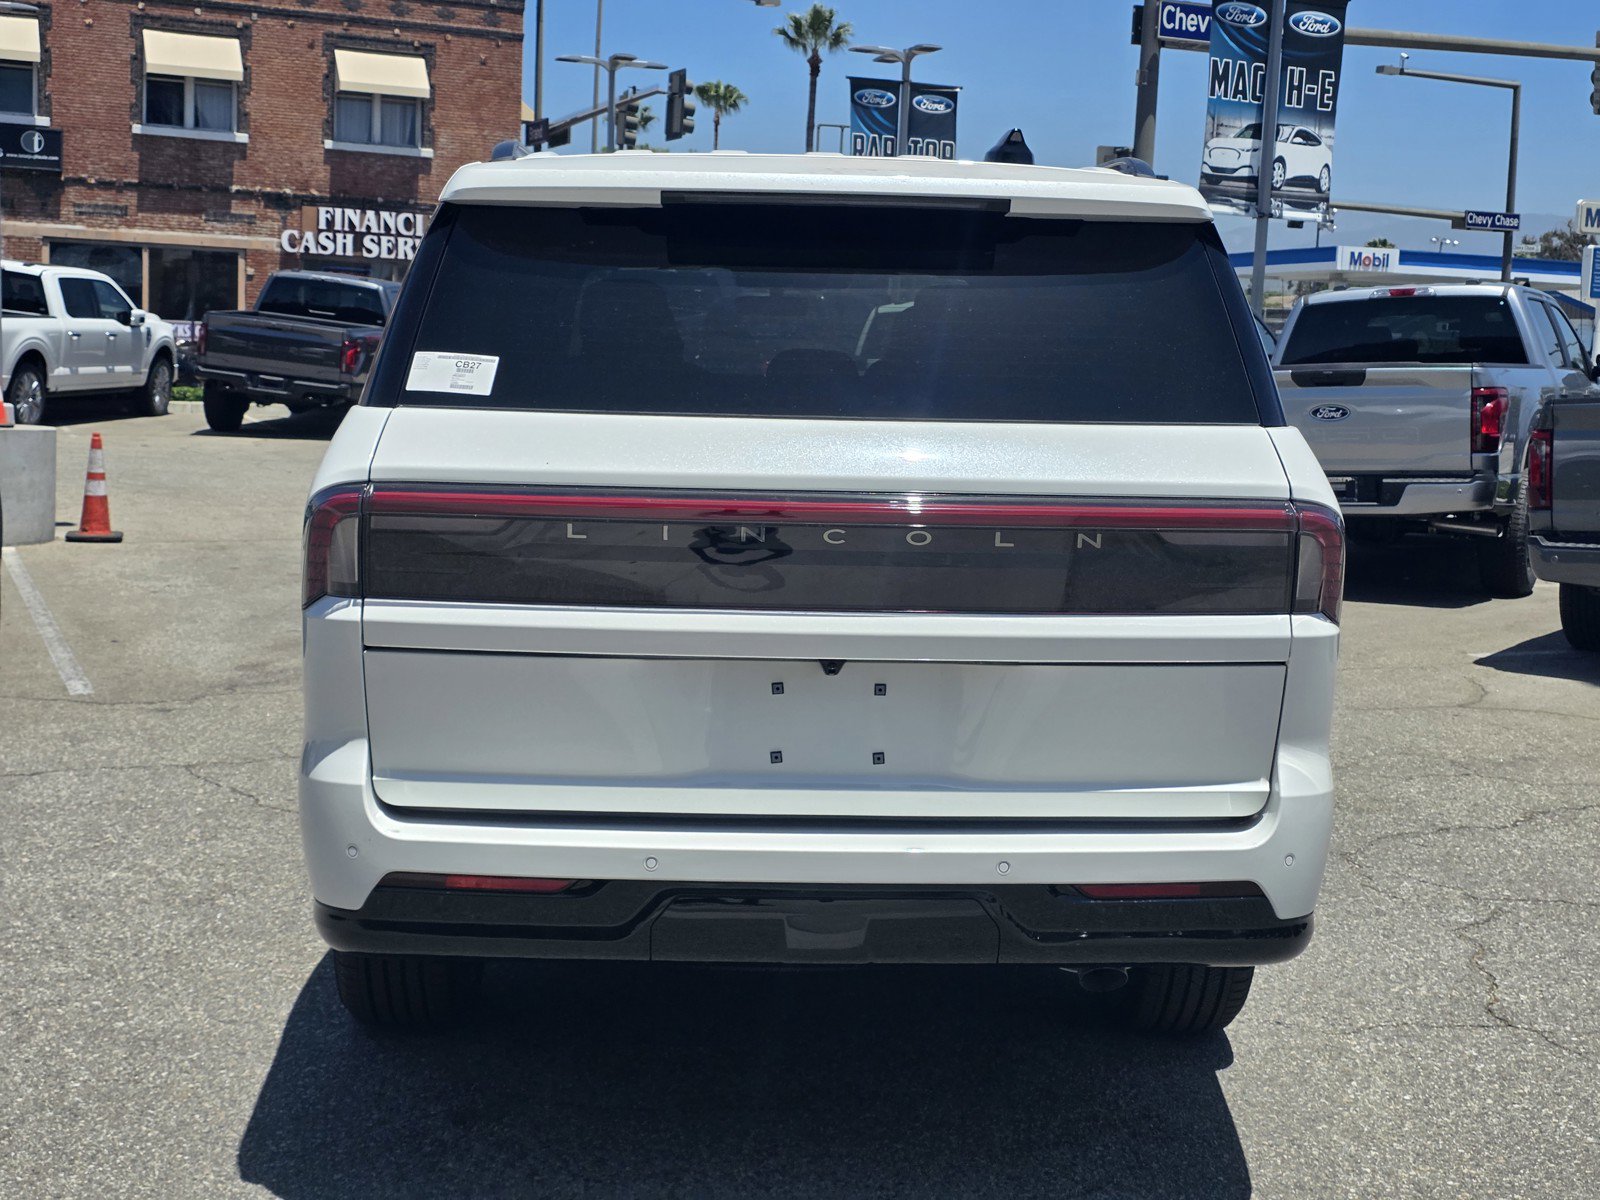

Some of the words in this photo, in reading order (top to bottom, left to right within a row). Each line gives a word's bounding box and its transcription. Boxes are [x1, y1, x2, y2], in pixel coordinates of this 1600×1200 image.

[1162, 4, 1212, 33] Chev
[1225, 6, 1257, 25] Ford
[1299, 14, 1331, 34] Ford
[861, 92, 888, 105] Ford
[920, 99, 946, 111] Ford
[317, 206, 433, 237] FINANCI
[1467, 212, 1493, 227] Chevy
[1495, 213, 1519, 227] Chase
[281, 229, 354, 257] CASH
[1349, 251, 1390, 268] Mobil
[455, 360, 482, 370] CB27
[1316, 407, 1343, 419] Ford
[566, 523, 1102, 549] LINCOLN
